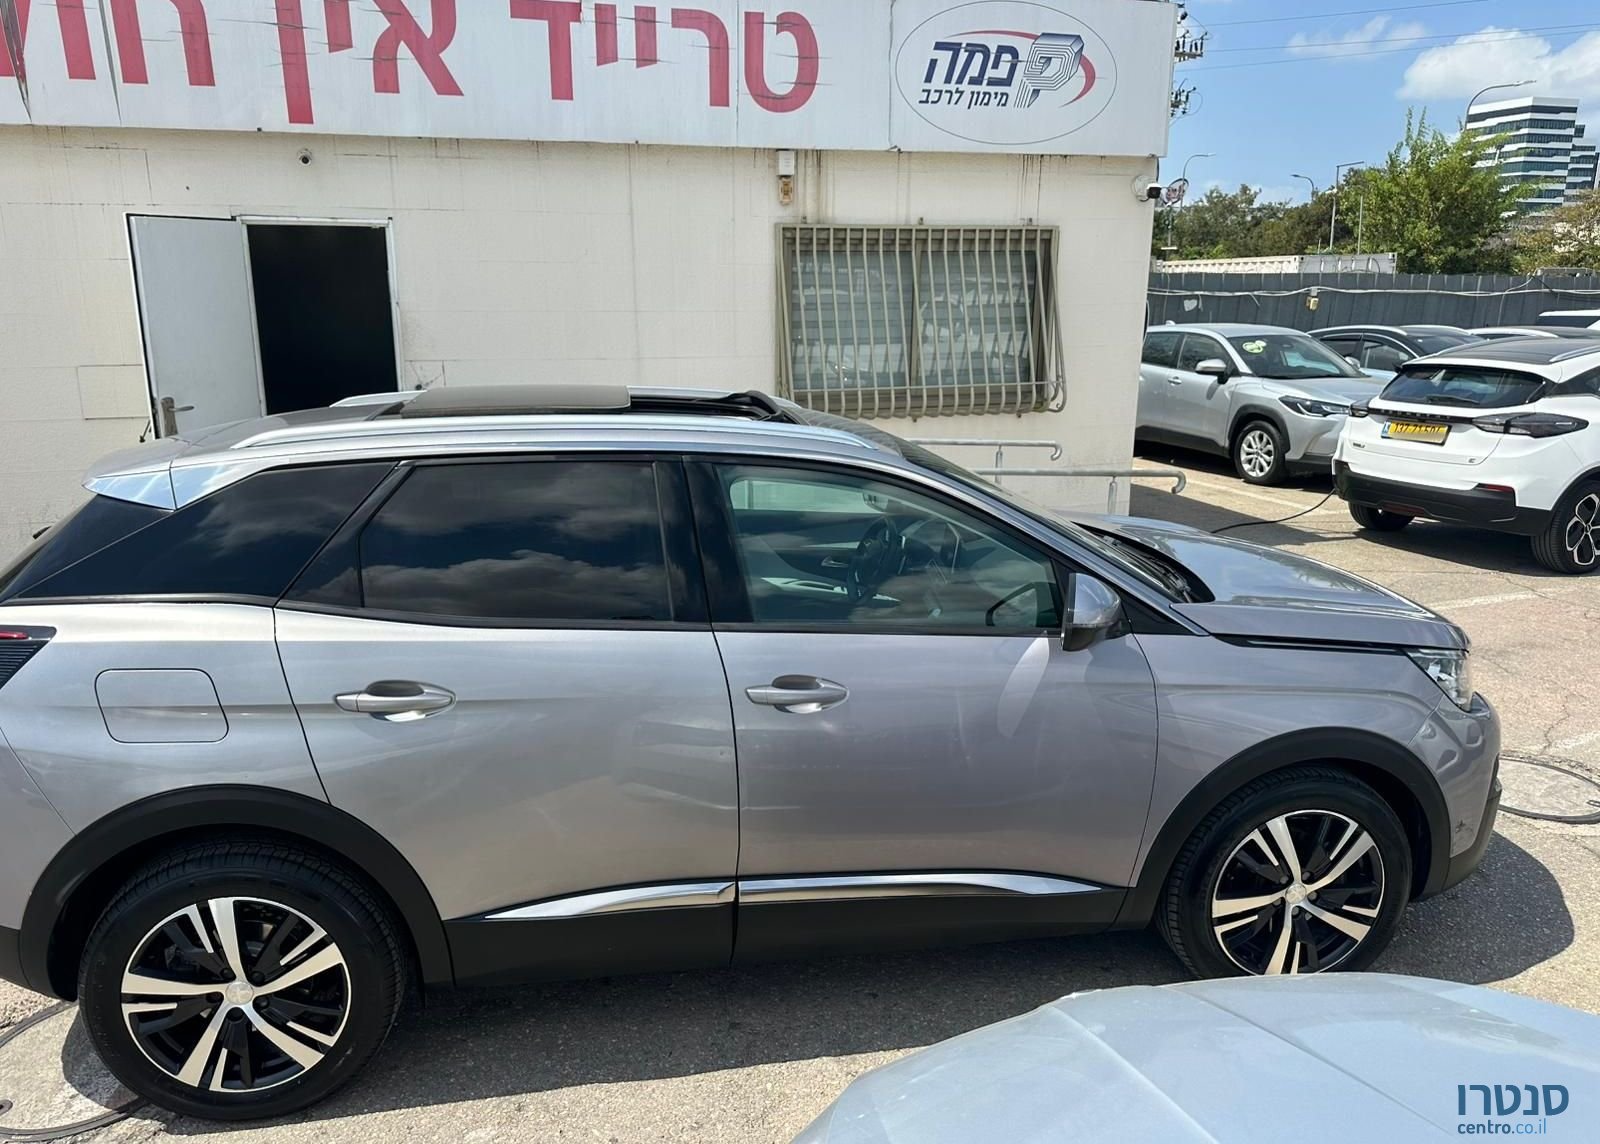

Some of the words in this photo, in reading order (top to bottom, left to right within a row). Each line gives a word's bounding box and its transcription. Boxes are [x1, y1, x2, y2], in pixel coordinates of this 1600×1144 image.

[275, 0, 465, 125] אין
[510, 0, 820, 113] טרייד
[923, 41, 1020, 87] פמה
[918, 87, 965, 105] לרכב
[967, 90, 1009, 109] מימון
